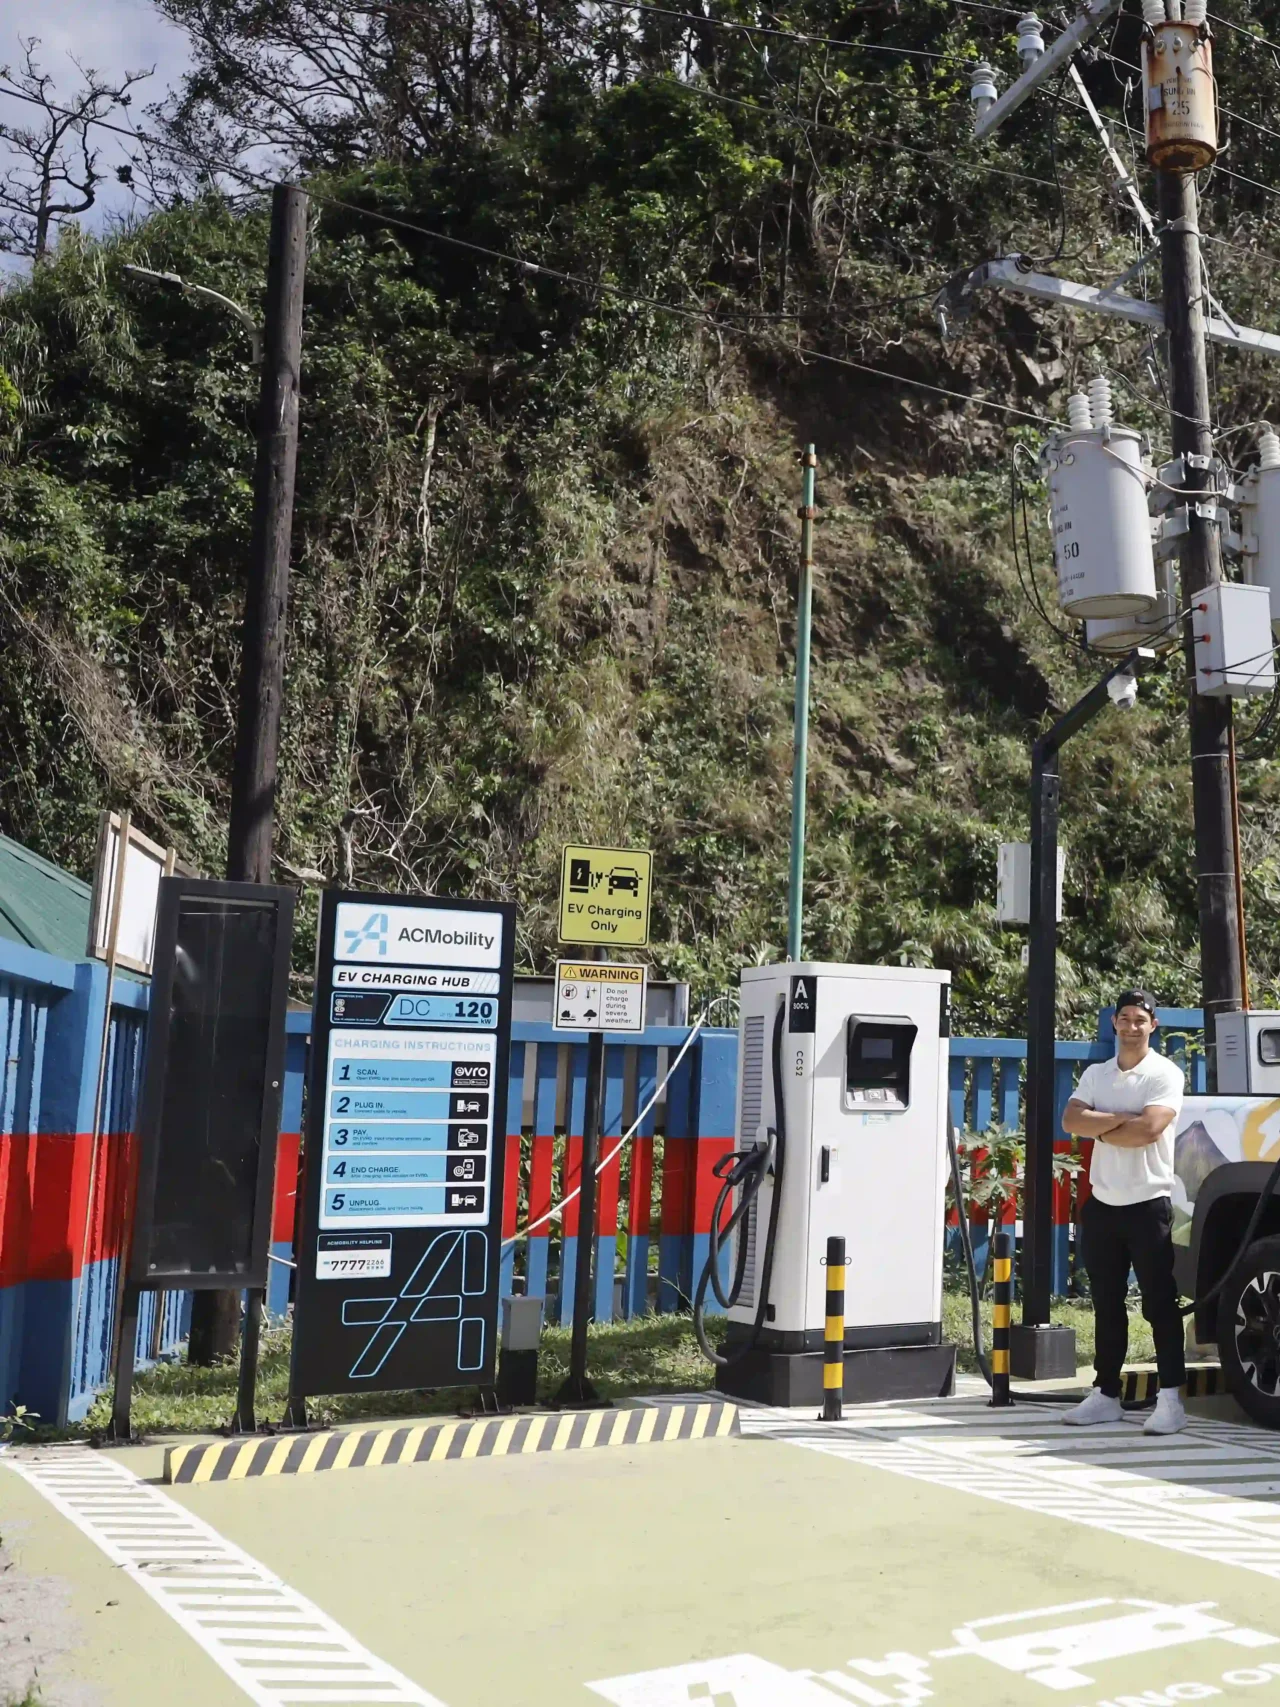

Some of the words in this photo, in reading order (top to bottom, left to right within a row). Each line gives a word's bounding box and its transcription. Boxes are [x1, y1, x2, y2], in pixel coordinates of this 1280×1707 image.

[1172, 100, 1190, 115] 25
[1064, 541, 1079, 560] 50
[568, 903, 584, 914] EV
[588, 904, 642, 920] Charging
[591, 921, 618, 933] Only
[398, 927, 494, 950] ACMobility
[338, 972, 357, 982] EV
[362, 973, 437, 986] CHARGING
[441, 976, 470, 987] HUB
[579, 968, 639, 980] WARNING
[794, 979, 808, 999] A
[400, 998, 430, 1016] DC
[455, 1001, 492, 1019] 120
[335, 1038, 401, 1050] CHARGING
[404, 1039, 491, 1052] INSTRUCTIONS
[339, 1064, 351, 1080] 1
[454, 1066, 488, 1077] evro
[336, 1096, 350, 1113] 2
[354, 1101, 374, 1109] PLUG
[334, 1128, 348, 1146] 3
[333, 1161, 347, 1178] 4
[331, 1194, 346, 1211] 5
